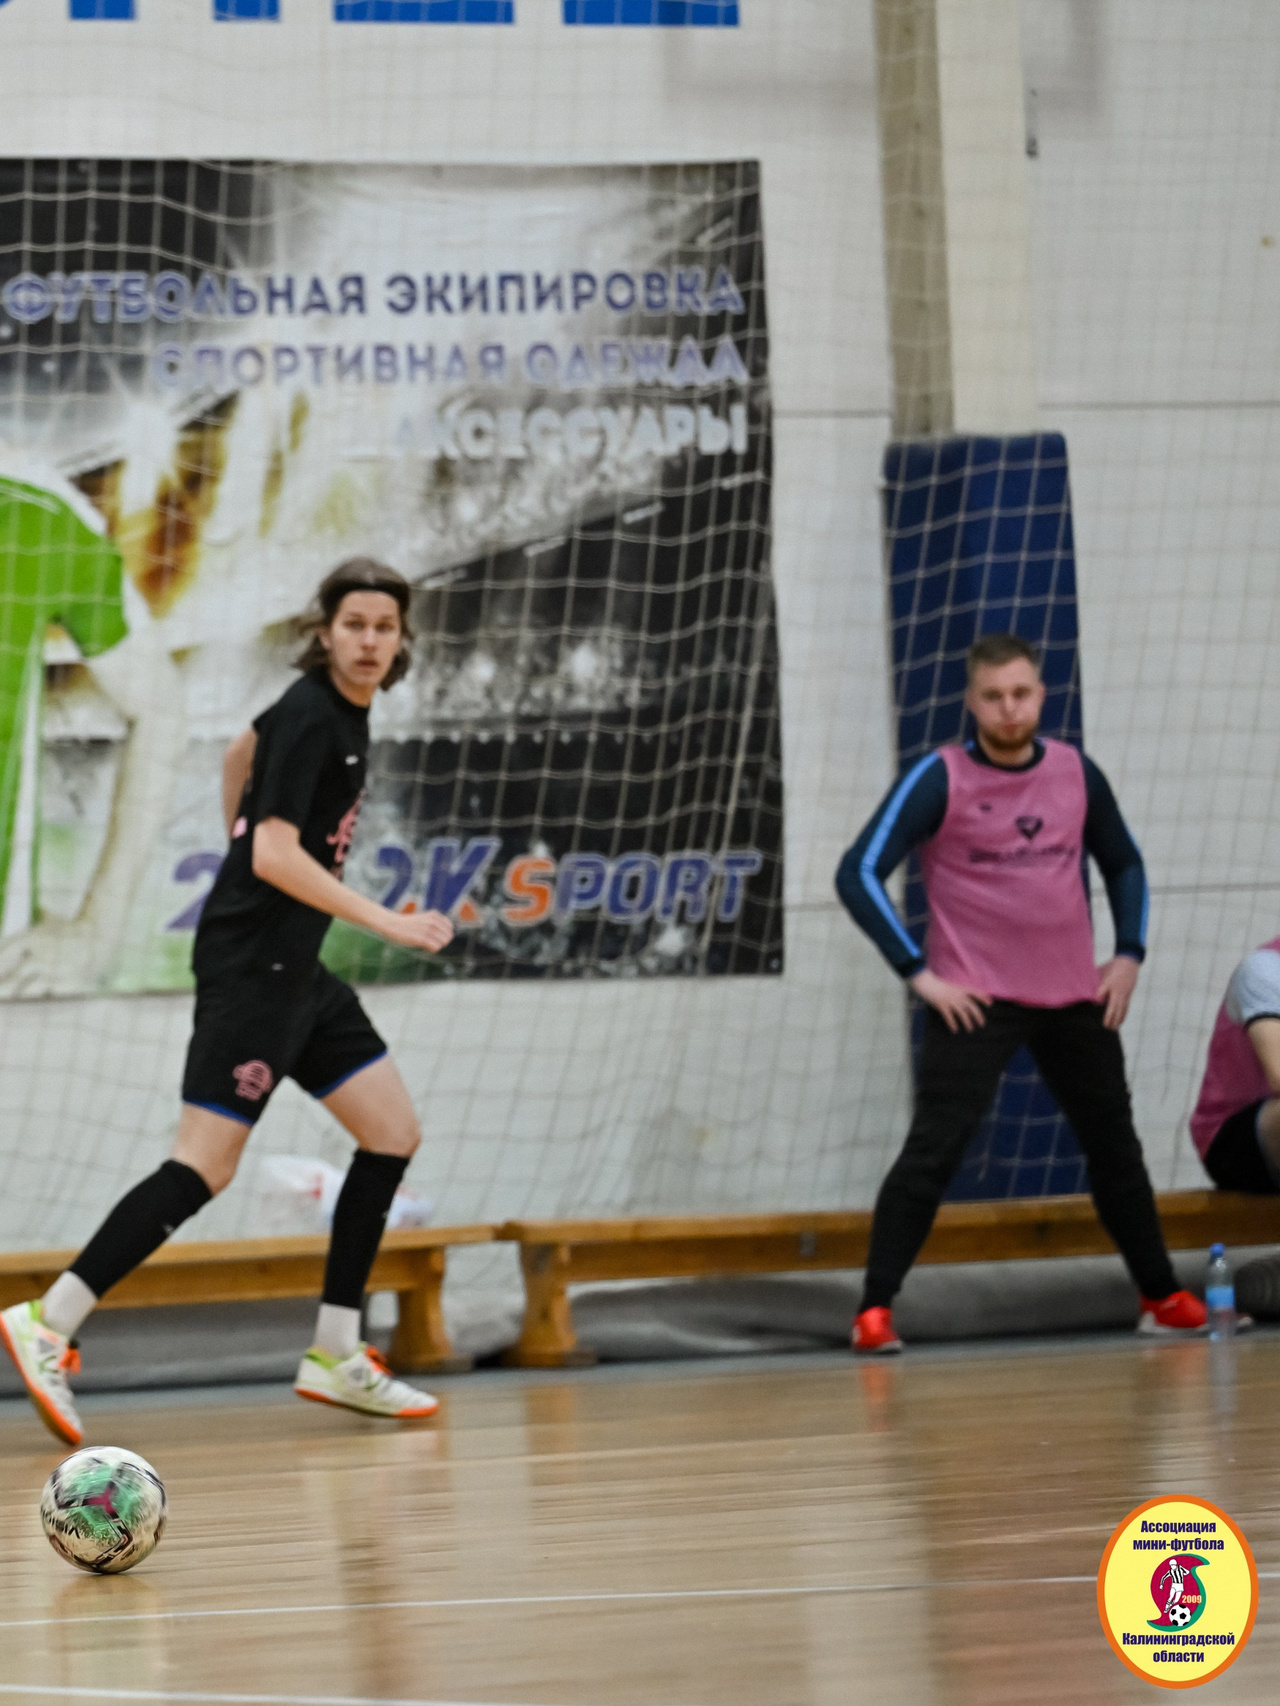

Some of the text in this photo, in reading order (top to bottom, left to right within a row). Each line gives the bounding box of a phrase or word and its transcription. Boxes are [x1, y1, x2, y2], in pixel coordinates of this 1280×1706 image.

[2, 266, 746, 324] ФУТБОЛЬНАЯ ЭКИПИРОВКА
[152, 334, 750, 389] СПОРТИВНАЯ ОДЕЖДА
[502, 848, 763, 926] SPORT
